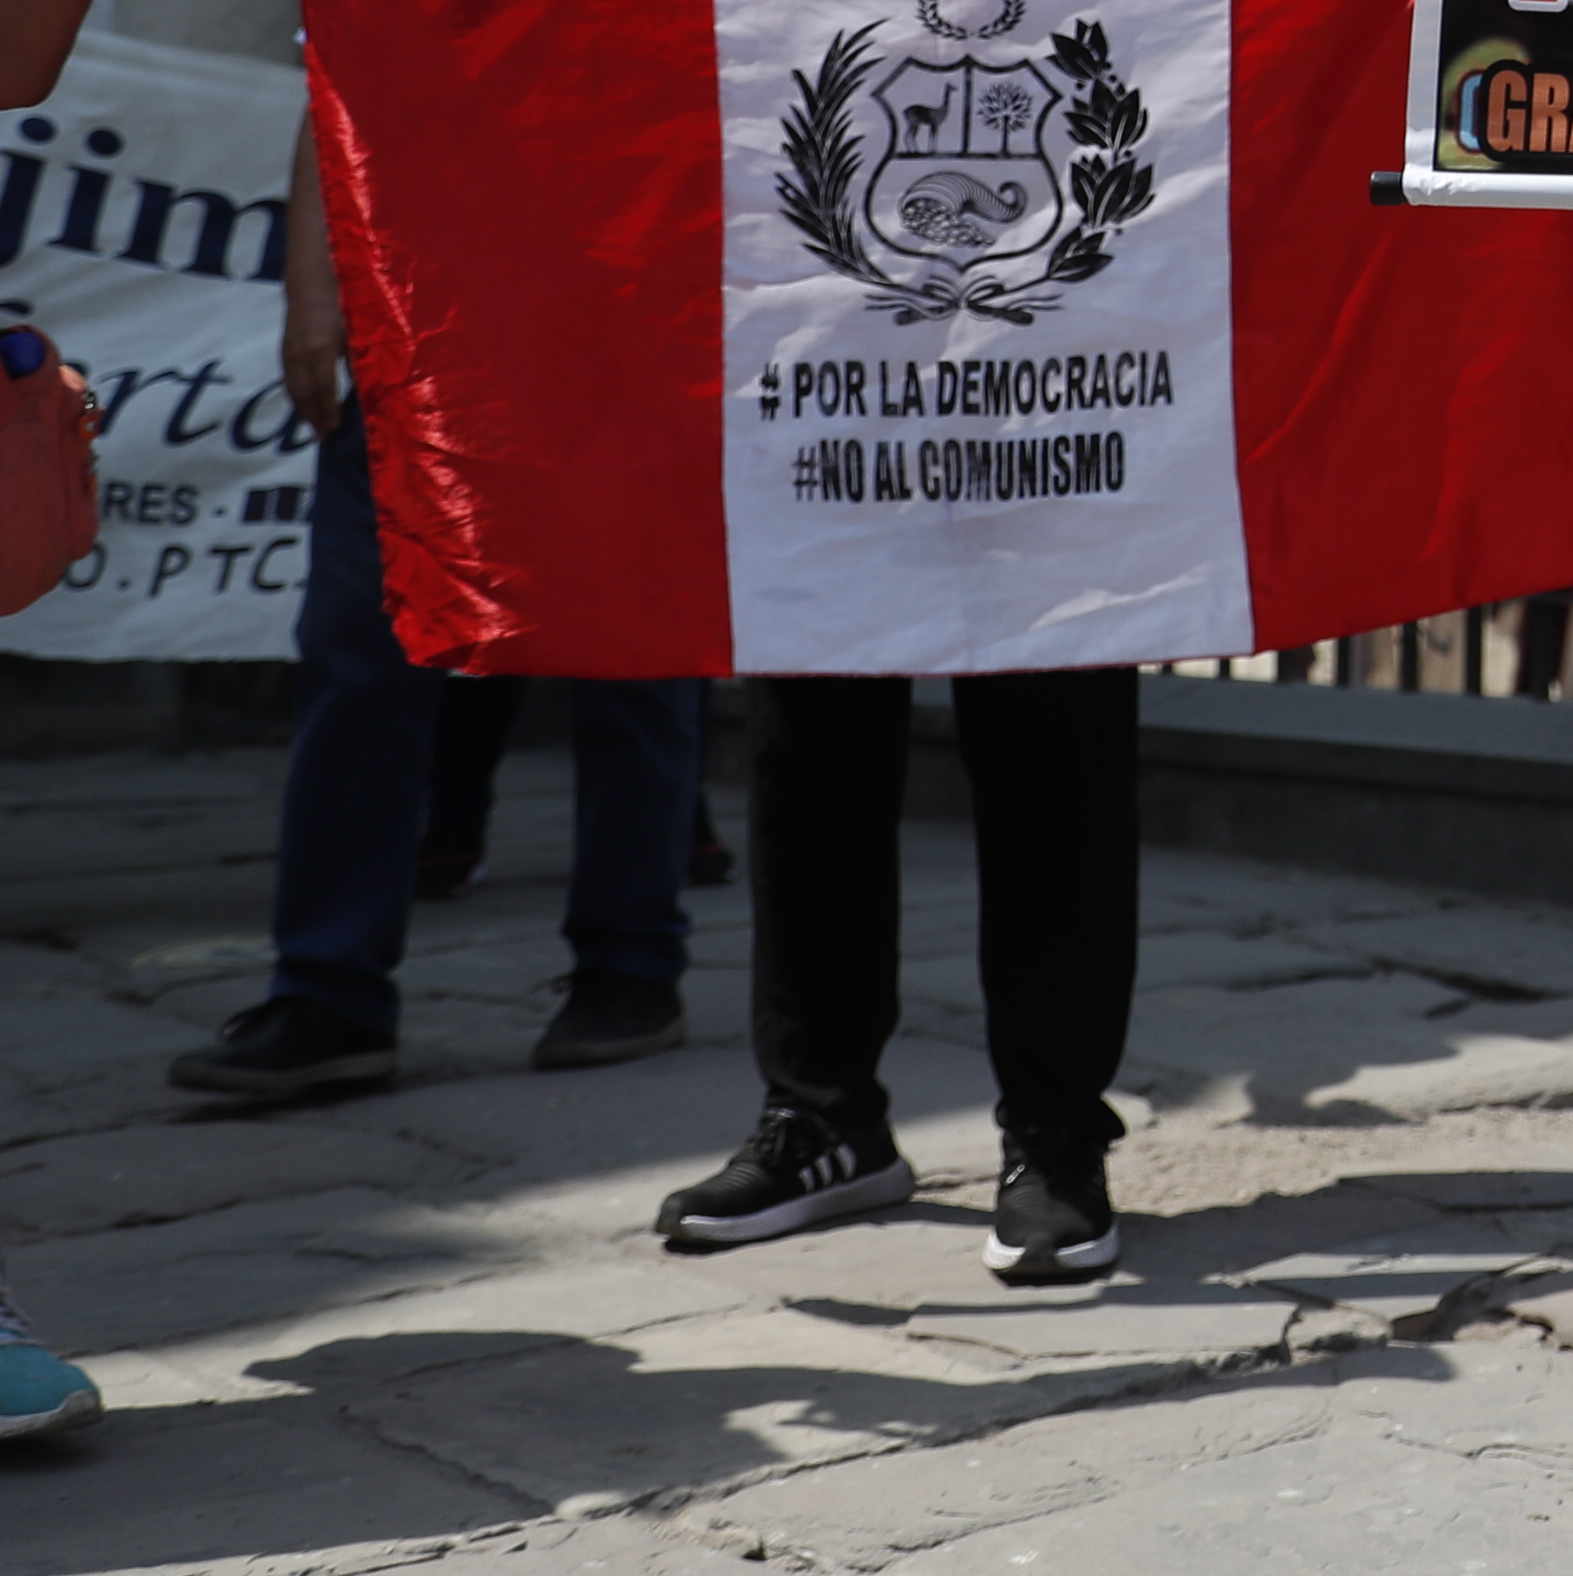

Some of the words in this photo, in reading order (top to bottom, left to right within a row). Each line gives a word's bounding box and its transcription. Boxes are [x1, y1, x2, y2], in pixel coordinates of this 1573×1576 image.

[880, 360, 924, 416] LA
[936, 350, 1172, 416] DEMOCRACIA
[793, 439, 863, 503] #NO
[874, 440, 913, 503] AL
[919, 430, 1125, 502] COMUNISMO
